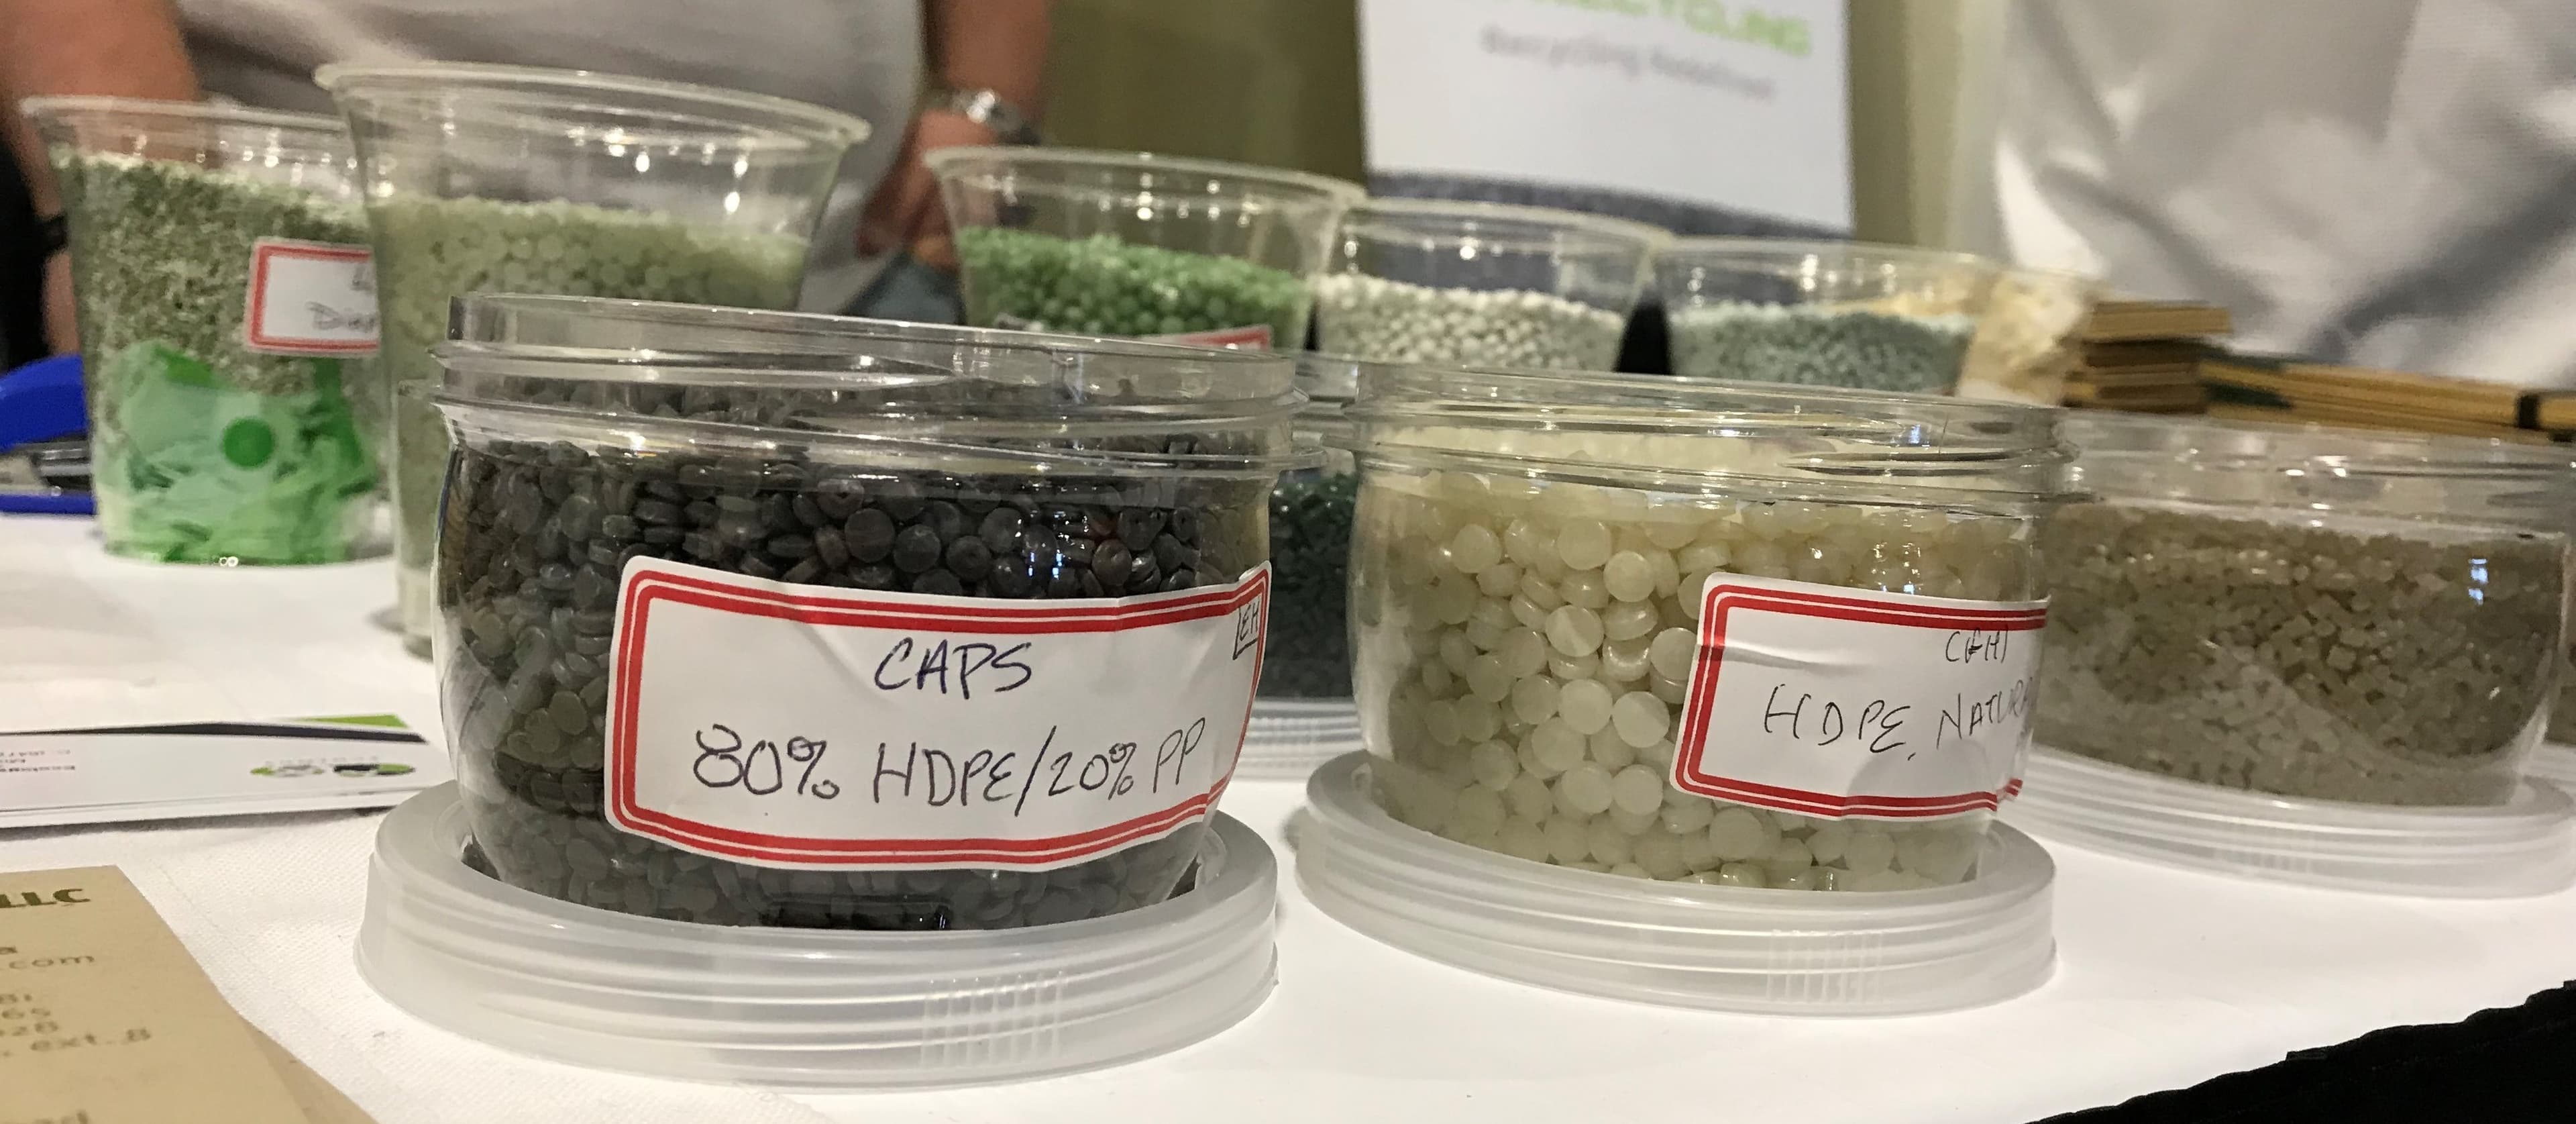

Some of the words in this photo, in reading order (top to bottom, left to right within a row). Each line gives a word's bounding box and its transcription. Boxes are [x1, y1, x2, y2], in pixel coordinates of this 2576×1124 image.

[874, 637, 1032, 700] CAPS
[693, 723, 840, 799] 80%
[872, 724, 1137, 817] HDPE/20%
[1152, 717, 1205, 794] PP
